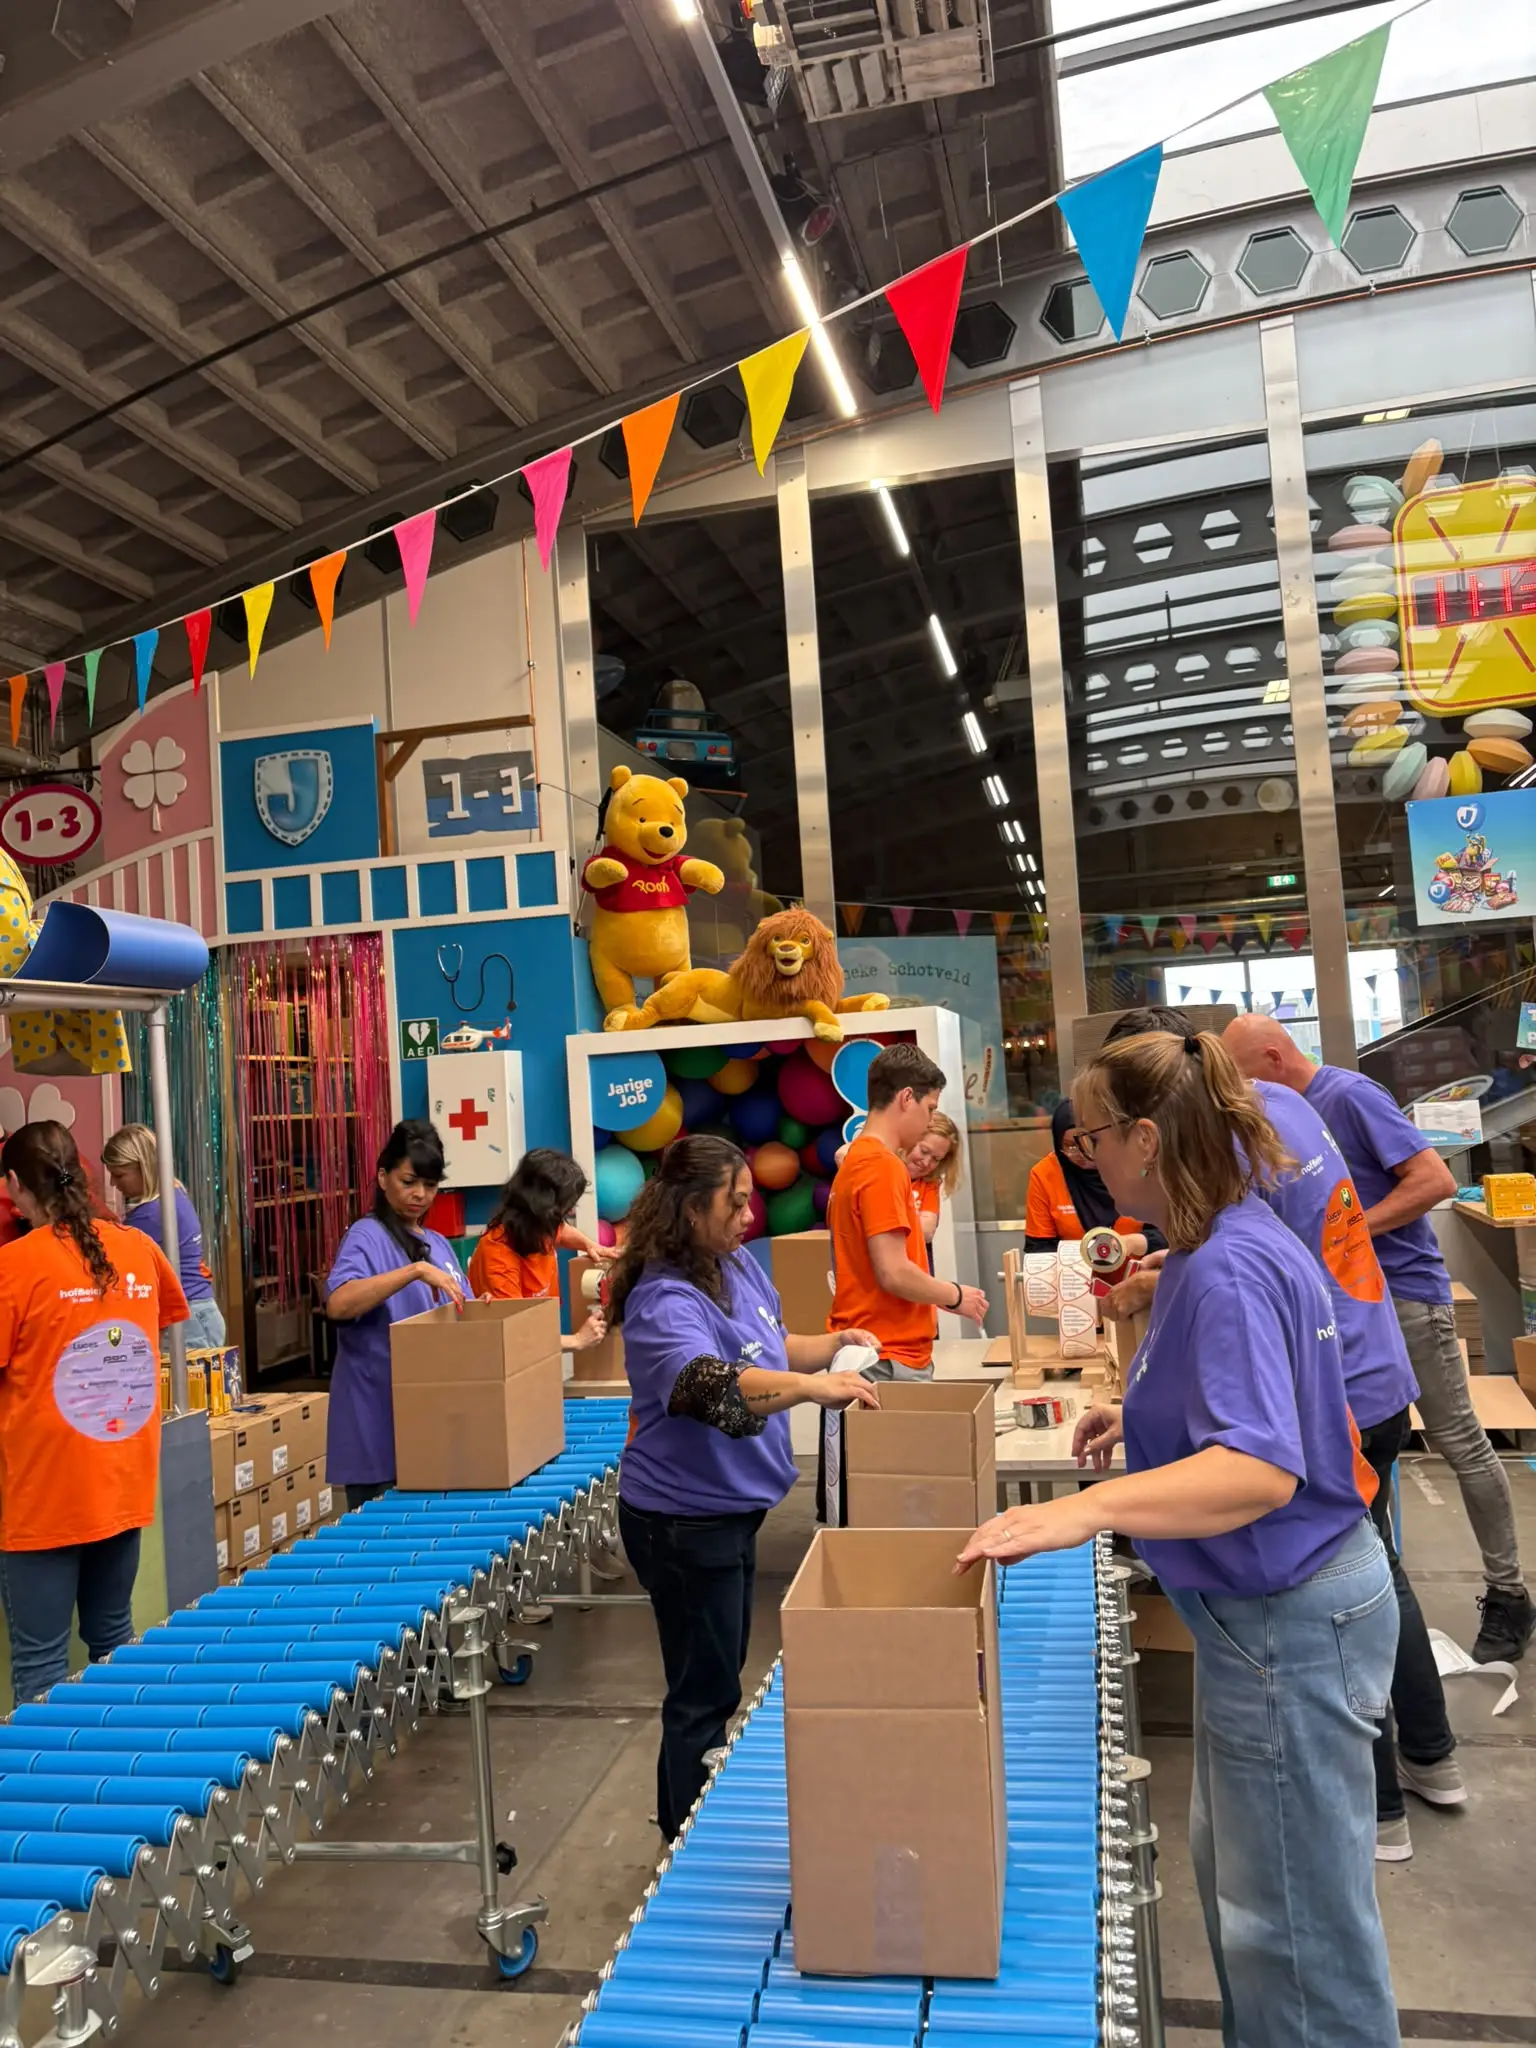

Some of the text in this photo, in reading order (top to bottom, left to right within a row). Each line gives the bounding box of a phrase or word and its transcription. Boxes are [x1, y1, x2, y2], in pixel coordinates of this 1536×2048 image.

[440, 767, 522, 819] 1-3
[15, 805, 82, 842] 1-3
[631, 876, 670, 895] Pooh
[888, 962, 971, 986] Schotveld
[407, 1046, 435, 1057] AED
[607, 1077, 653, 1097] Jarige
[619, 1091, 648, 1108] Job
